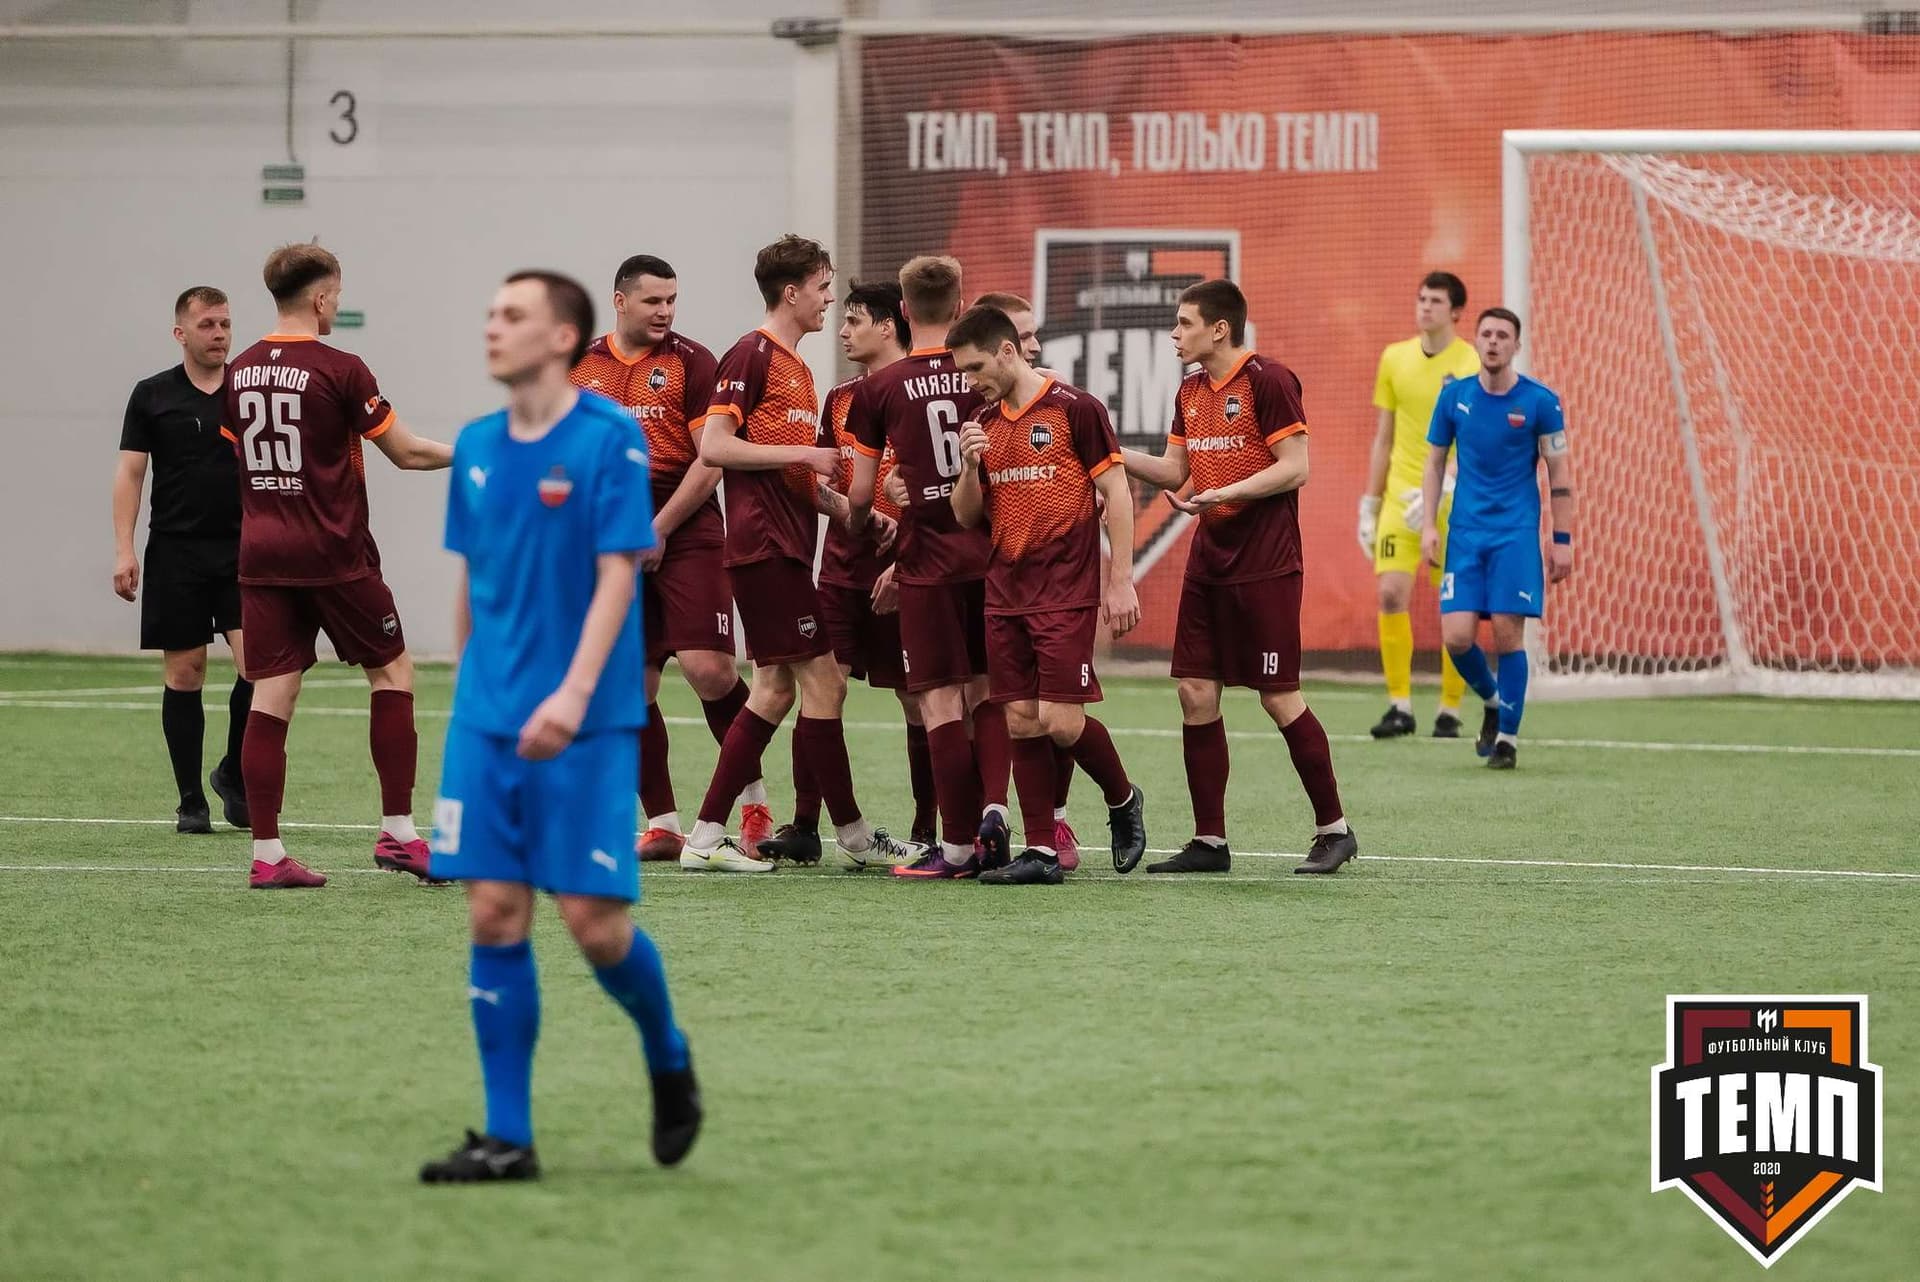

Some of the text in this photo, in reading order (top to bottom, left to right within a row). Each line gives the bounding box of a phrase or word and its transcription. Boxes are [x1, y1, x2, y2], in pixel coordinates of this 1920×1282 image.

[329, 90, 359, 144] 3
[906, 111, 1380, 176] ТЕМП, ТЕМП, ТОЛЬКО ТЕМП!
[233, 365, 311, 392] НОВИЧКОВ
[1041, 328, 1203, 436] ТЕМ
[238, 391, 303, 473] 25
[926, 399, 962, 478] 6
[250, 476, 303, 490] SEUS
[922, 481, 955, 501] SE
[1381, 535, 1396, 560] 16
[716, 612, 729, 636] 13
[903, 650, 911, 673] 6
[1262, 652, 1279, 675] 19
[1081, 663, 1089, 687] 5
